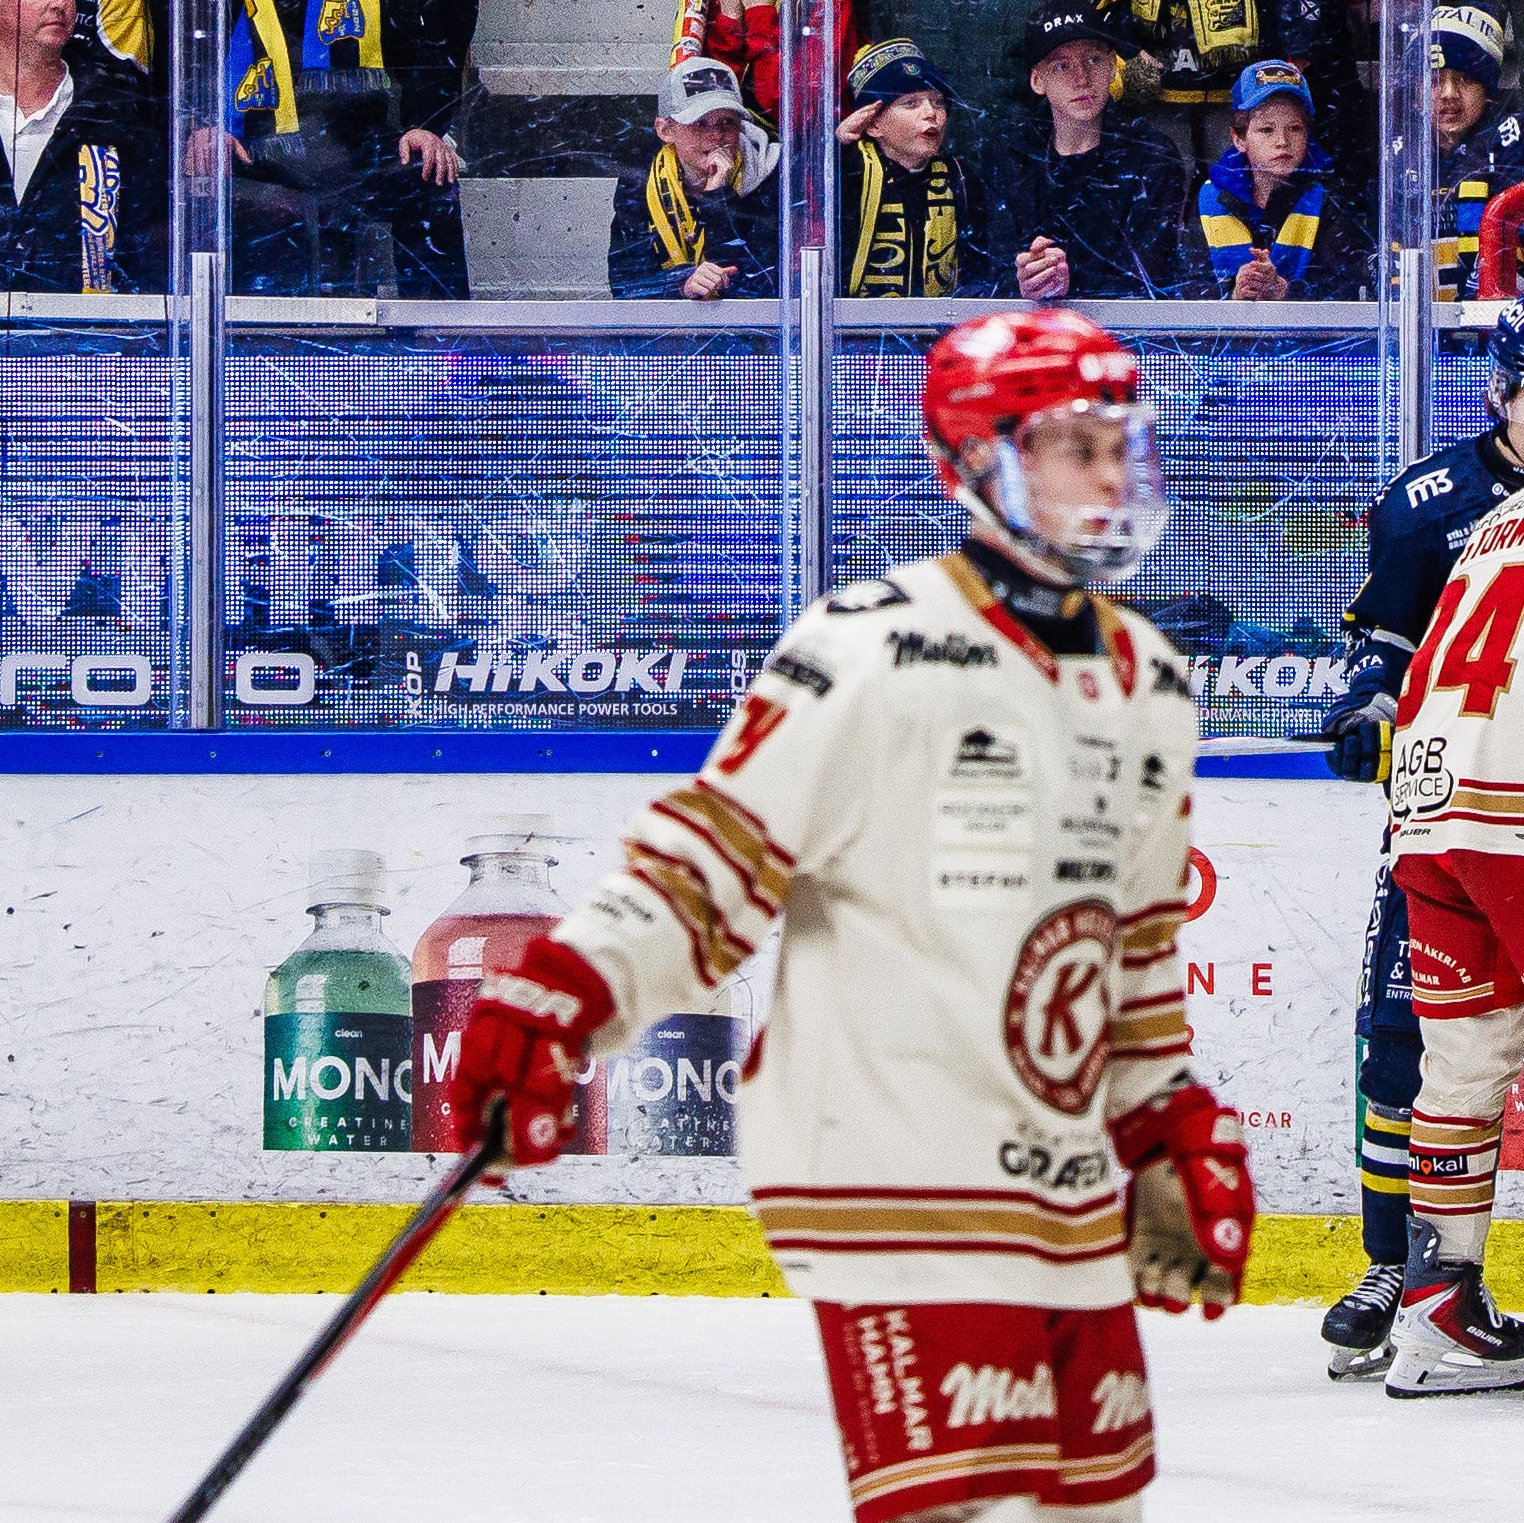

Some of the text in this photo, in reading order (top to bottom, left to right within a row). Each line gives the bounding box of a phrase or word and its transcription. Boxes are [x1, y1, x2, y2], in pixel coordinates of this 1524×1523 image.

[1043, 14, 1085, 33] DRAX
[435, 652, 689, 693] HiKOKI
[434, 702, 679, 717] HIGH PERFORMANCE POWER TOOLS
[334, 1028, 364, 1040] clean
[656, 1028, 685, 1040] clean
[1465, 1325, 1504, 1347] BAUER
